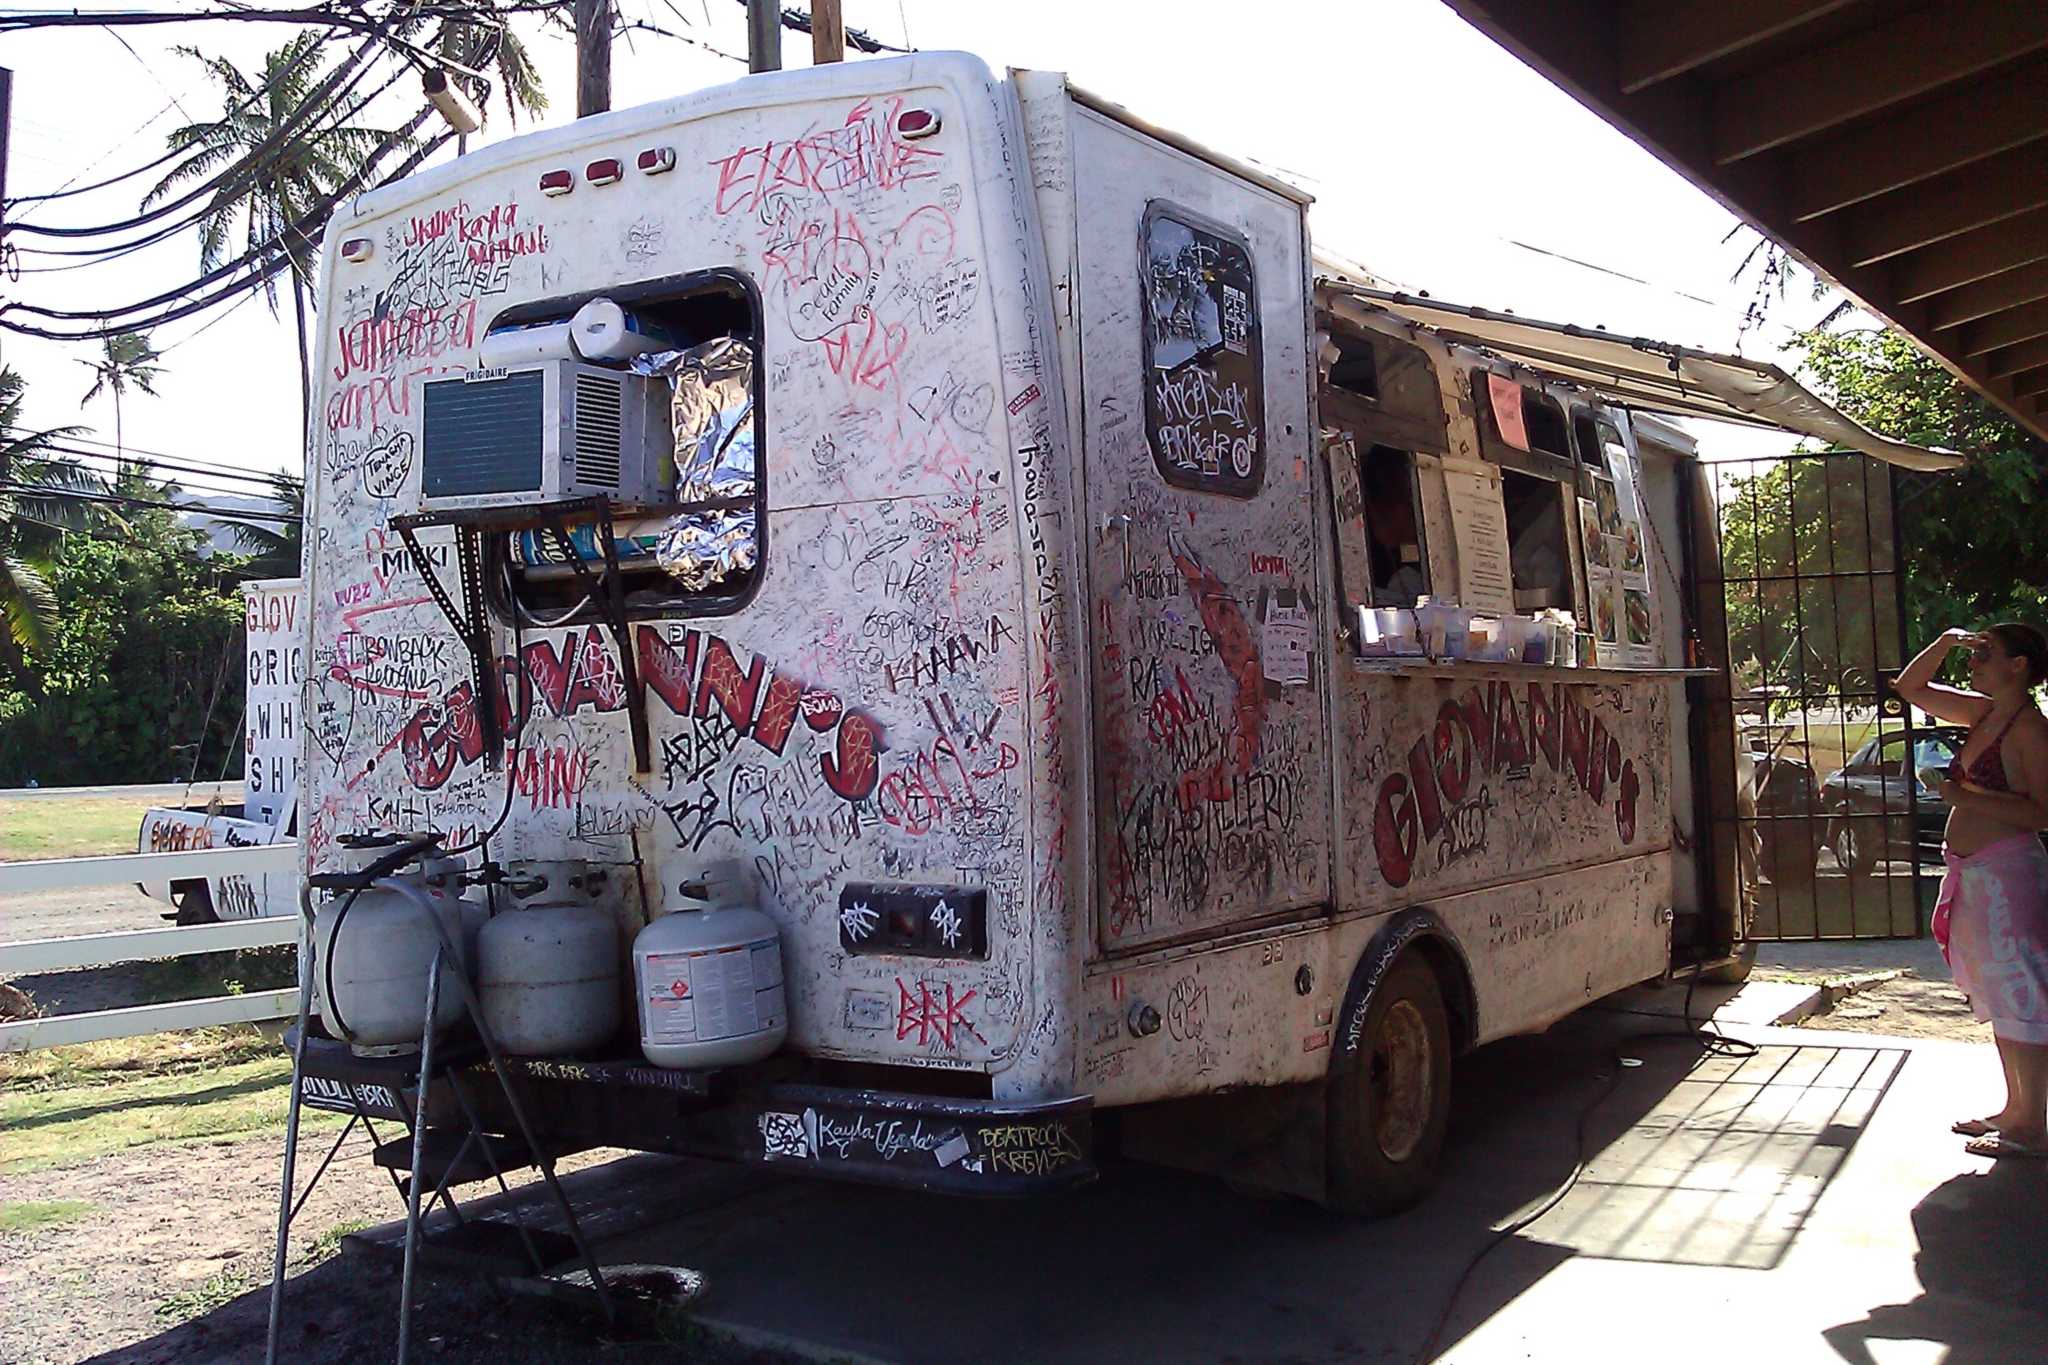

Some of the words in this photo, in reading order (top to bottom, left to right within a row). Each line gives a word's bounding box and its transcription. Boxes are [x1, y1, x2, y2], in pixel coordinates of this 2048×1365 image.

[465, 367, 508, 381] FRIGIDAIRE
[373, 459, 407, 494] VINCE
[382, 545, 448, 577] MIKI
